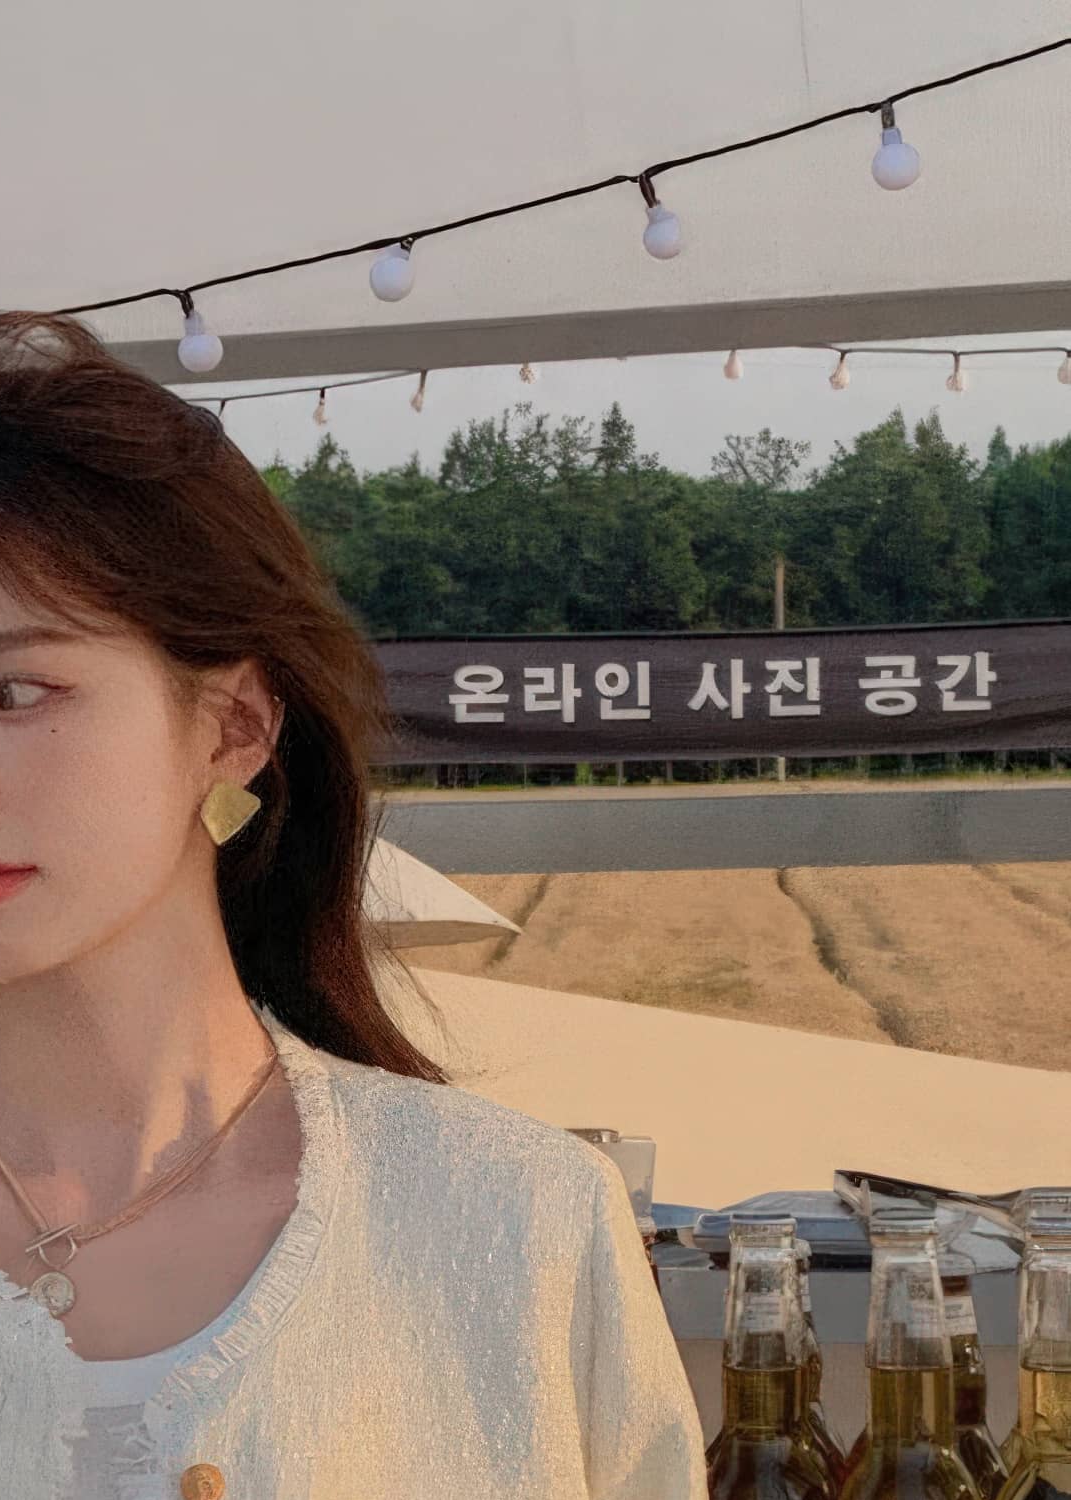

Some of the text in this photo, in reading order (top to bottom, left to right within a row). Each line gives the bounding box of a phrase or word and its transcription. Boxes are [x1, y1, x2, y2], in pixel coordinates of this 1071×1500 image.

[449, 651, 998, 723] 온라인 사진 공간
